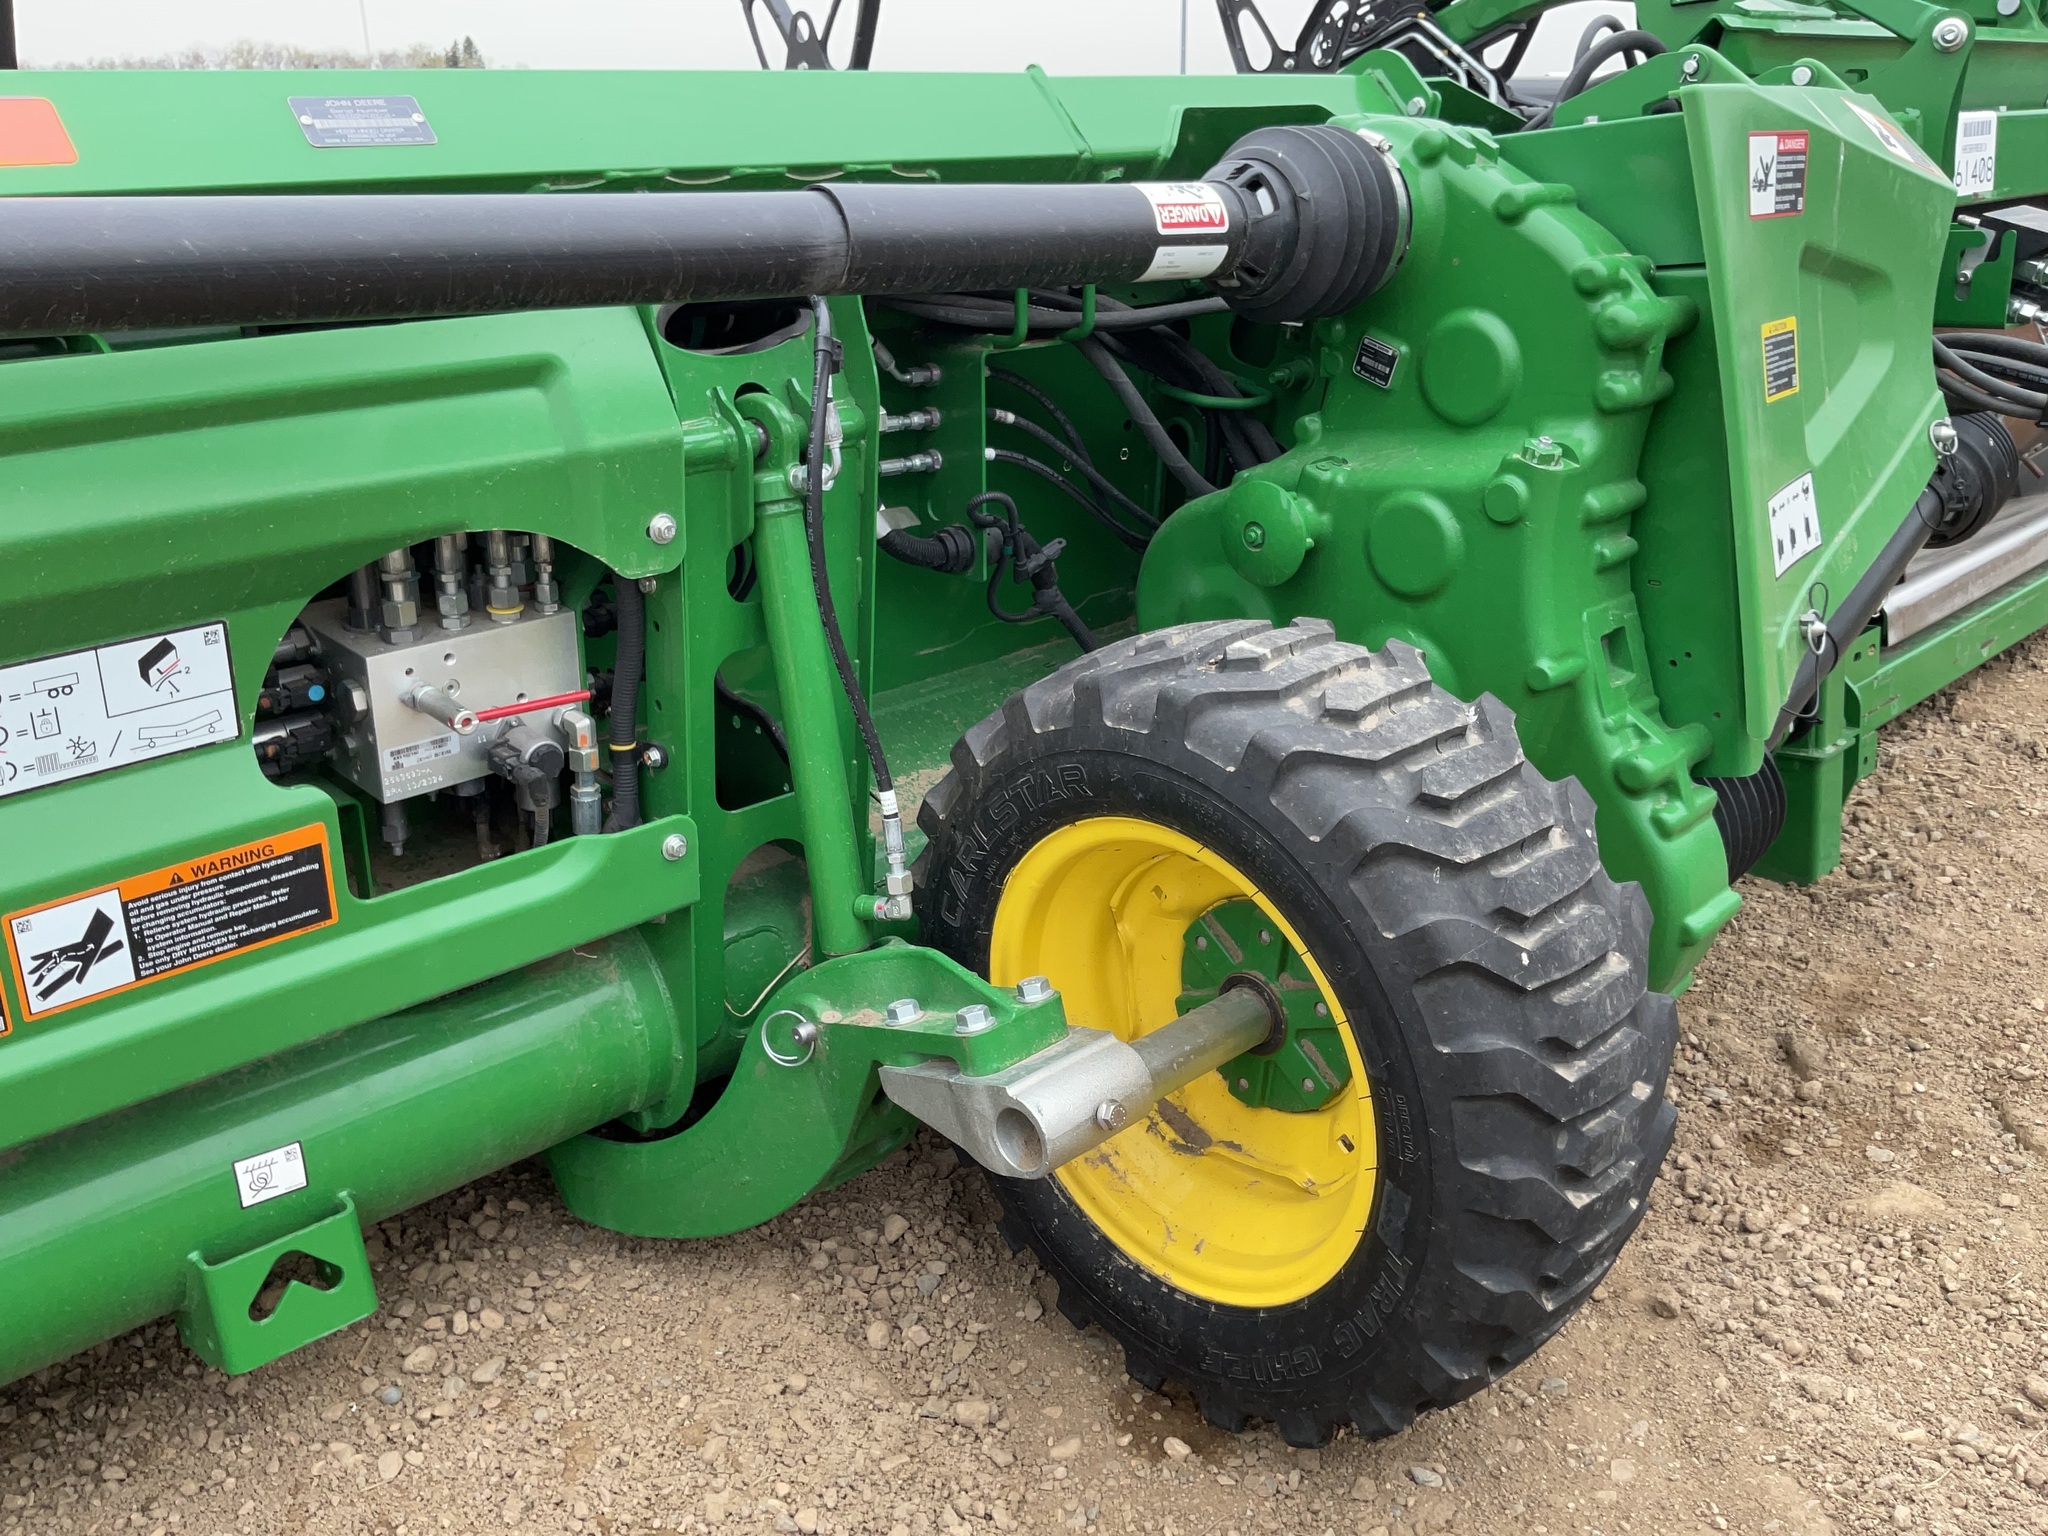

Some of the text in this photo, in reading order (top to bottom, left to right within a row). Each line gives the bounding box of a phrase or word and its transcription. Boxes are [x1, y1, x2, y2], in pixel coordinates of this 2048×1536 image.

[1784, 139, 1805, 149] DANGER
[1955, 156, 1993, 187] 61408
[1158, 205, 1209, 223] DANGER
[807, 444, 814, 458] DN
[807, 528, 814, 542] EN
[191, 844, 274, 878] WARNING
[941, 764, 1094, 928] CARLSTAR
[127, 854, 293, 909] Avoid serious injury from contact with hydraulic
[129, 882, 226, 916] oil and gas under pressure.
[130, 862, 319, 924] Before removing hydraulic components, disassembling
[1283, 866, 1317, 910] RATED
[141, 913, 175, 930] changing
[176, 898, 226, 918] accumulators:
[143, 923, 170, 936] Relieve
[171, 915, 197, 928] system
[198, 904, 231, 920] hydraulic
[232, 893, 268, 910] pressures.
[271, 886, 289, 897] Refer
[154, 926, 186, 941] Operator
[187, 917, 213, 930] Manual
[214, 913, 228, 922] and
[229, 905, 252, 918] Repair
[253, 897, 277, 910] Manual
[278, 894, 288, 902] for
[139, 907, 320, 969] Use only DRY NITROGEN for recharging accumulator.
[146, 924, 216, 952] system information.
[147, 948, 165, 959] Stop
[166, 940, 191, 954] engine
[192, 935, 205, 945] and
[206, 927, 232, 940] remove
[234, 922, 247, 932] key.
[140, 940, 238, 977] See your John Deere dealer.
[1396, 1094, 1414, 1163] DIRECTION
[1334, 1250, 1413, 1359] TRAC
